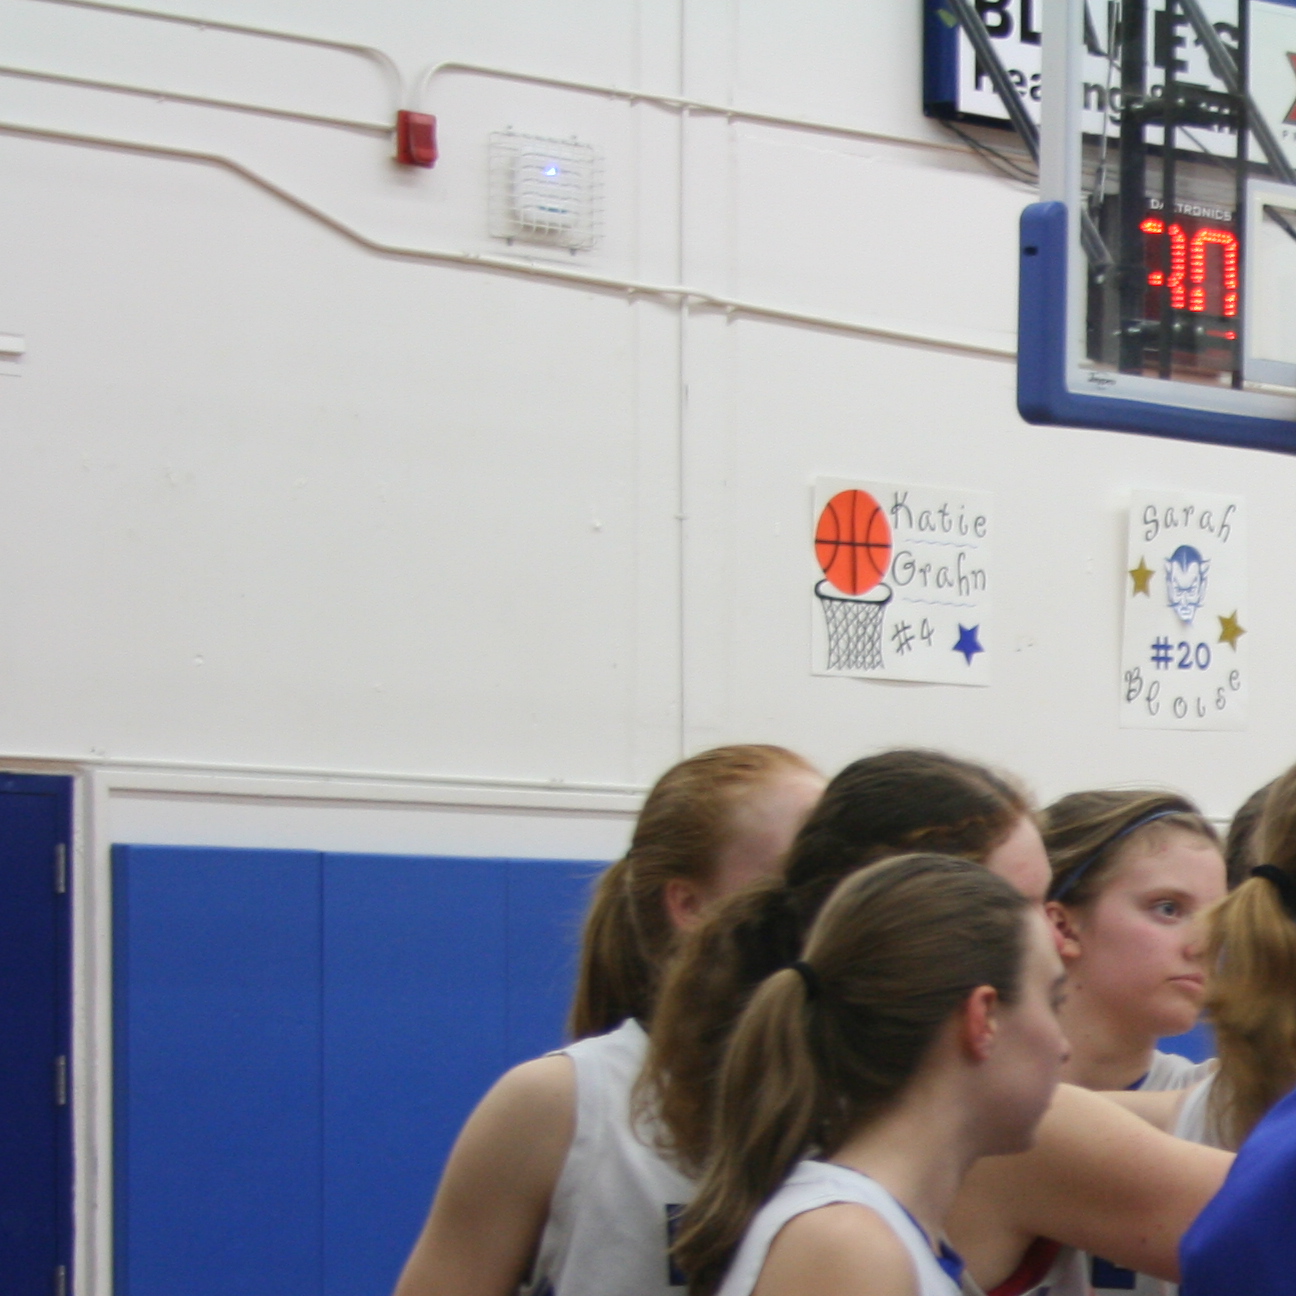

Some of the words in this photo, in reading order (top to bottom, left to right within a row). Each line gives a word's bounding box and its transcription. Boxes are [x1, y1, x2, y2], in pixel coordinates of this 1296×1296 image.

[1150, 199, 1232, 221] DTRONICS
[890, 492, 986, 537] Katie
[1142, 504, 1236, 543] Sarah
[891, 551, 986, 596] Grahn
[891, 618, 935, 655] #4
[1151, 636, 1212, 670] #20
